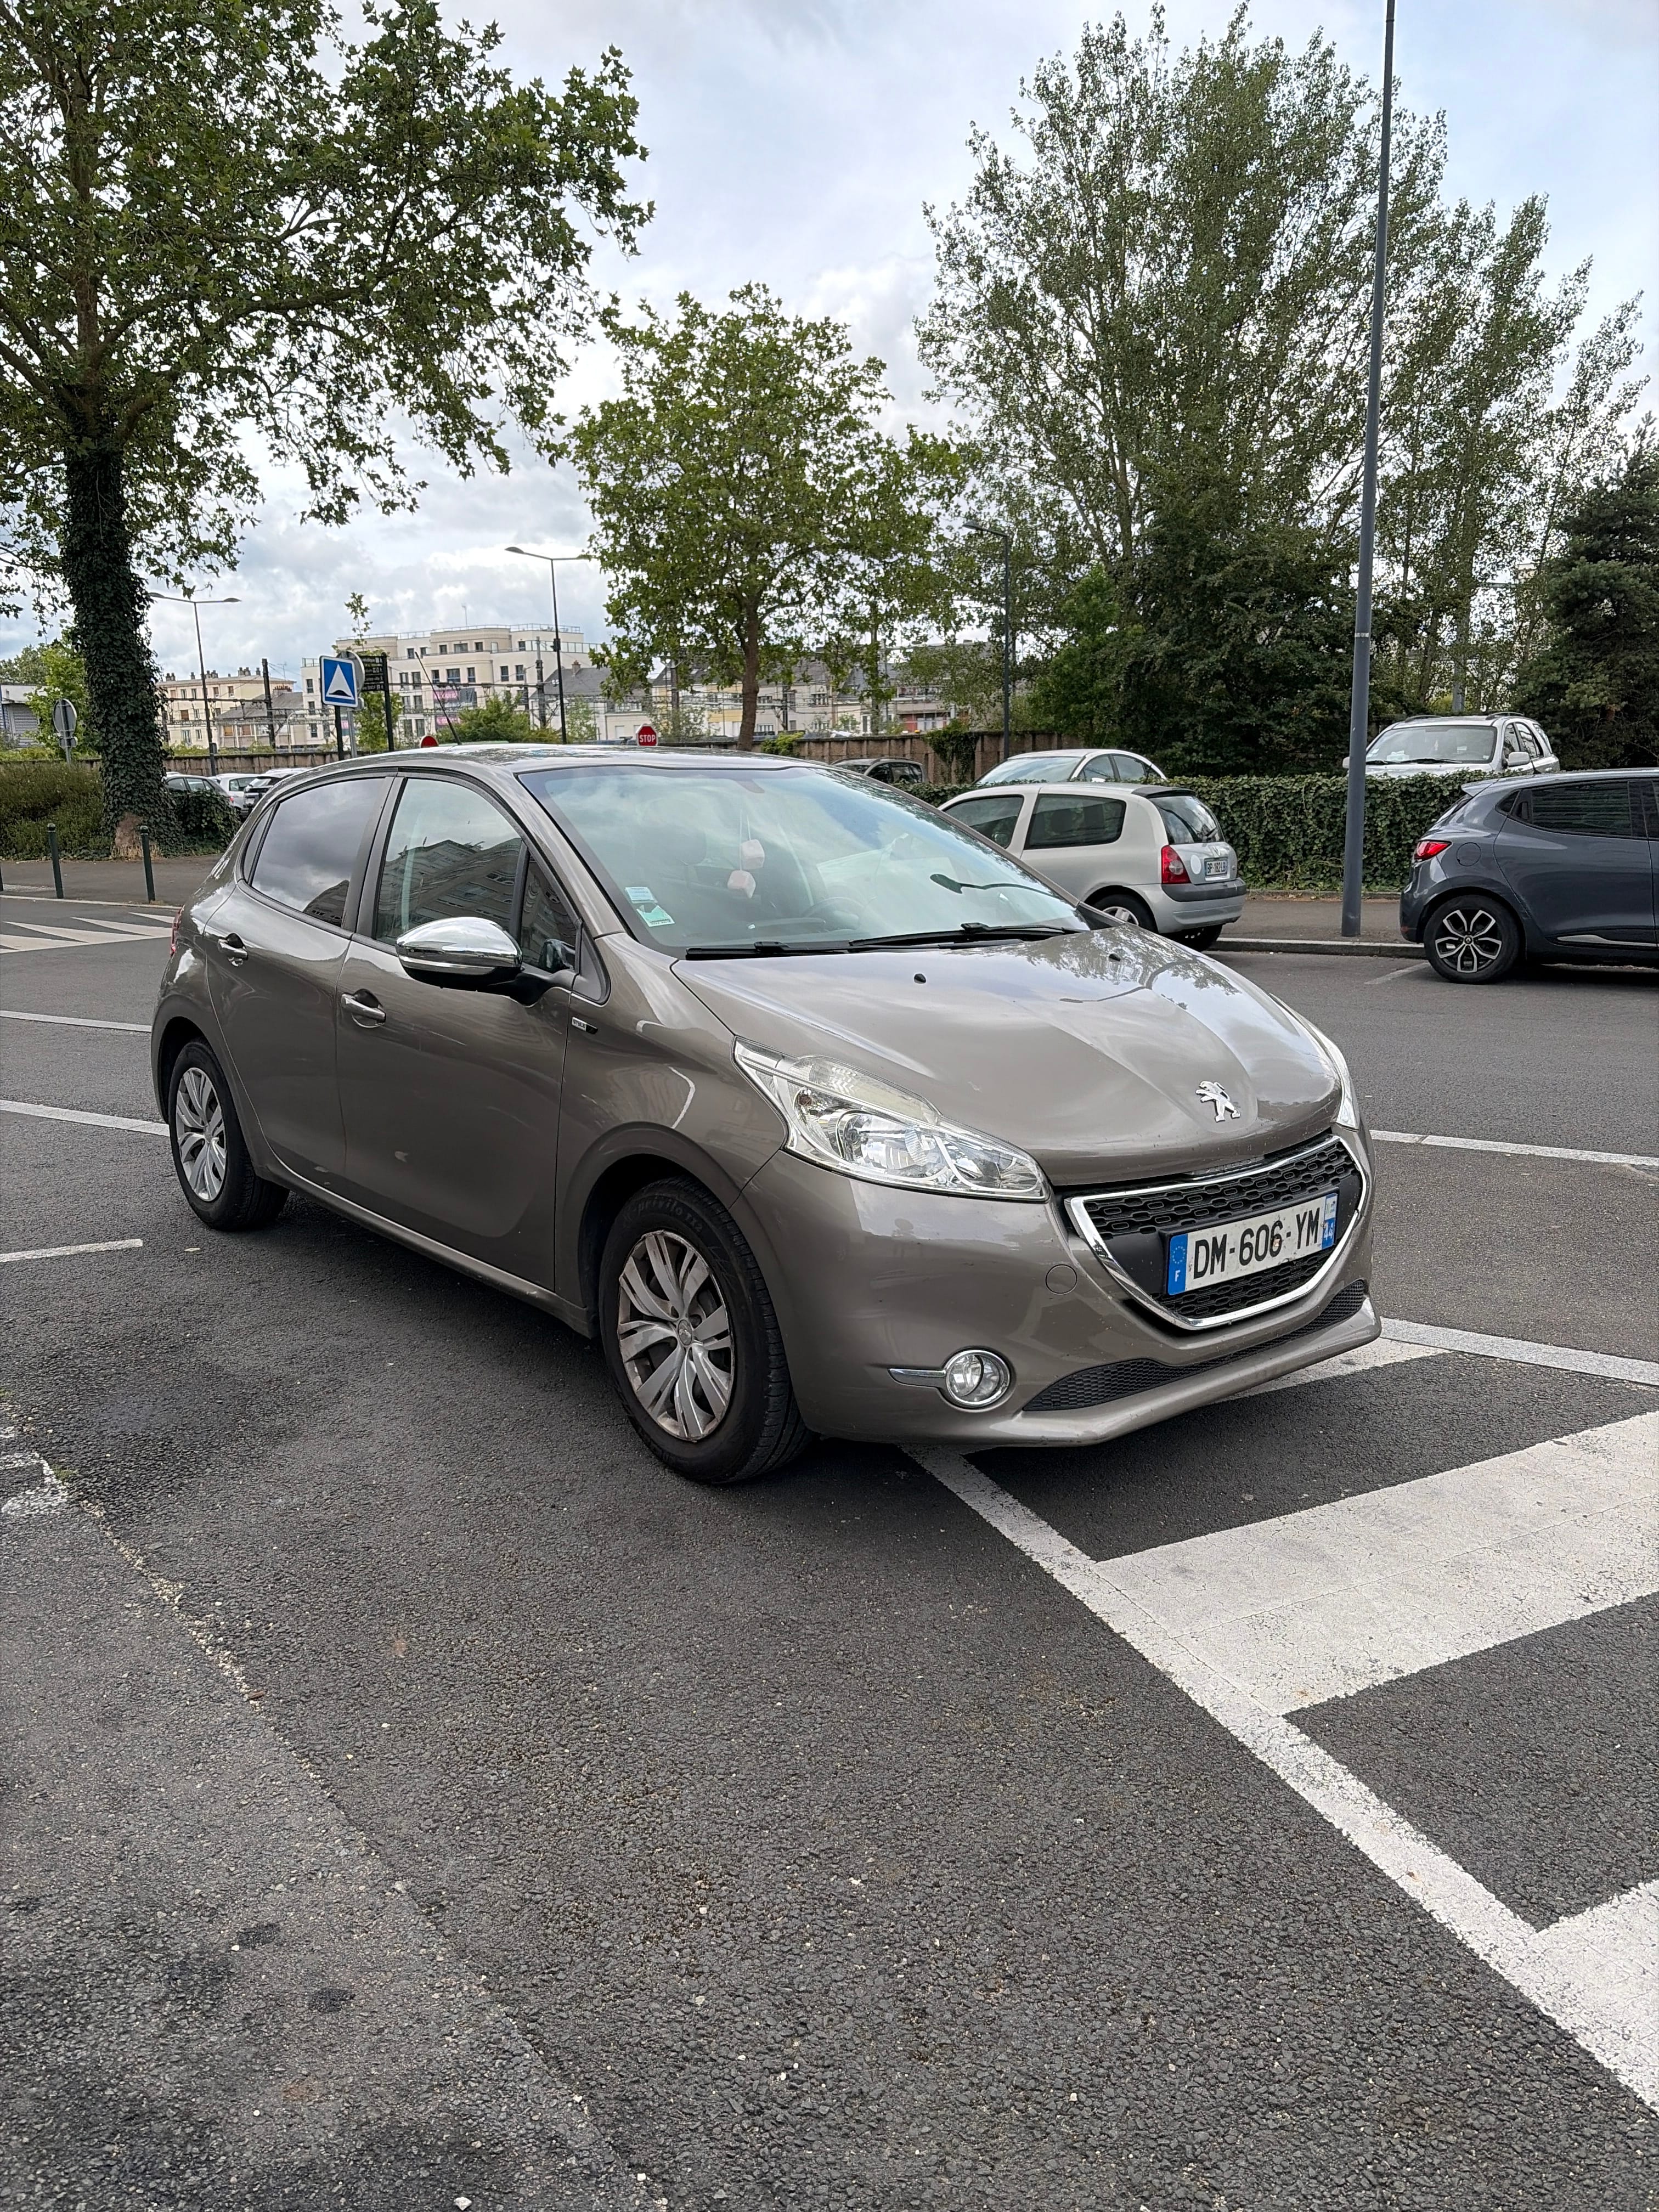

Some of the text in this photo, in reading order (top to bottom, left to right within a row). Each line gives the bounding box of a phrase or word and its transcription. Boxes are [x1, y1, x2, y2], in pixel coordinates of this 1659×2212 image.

[639, 734, 656, 743] STOP
[1193, 1207, 1321, 1280] DM-606-YM
[1174, 1269, 1181, 1282] F
